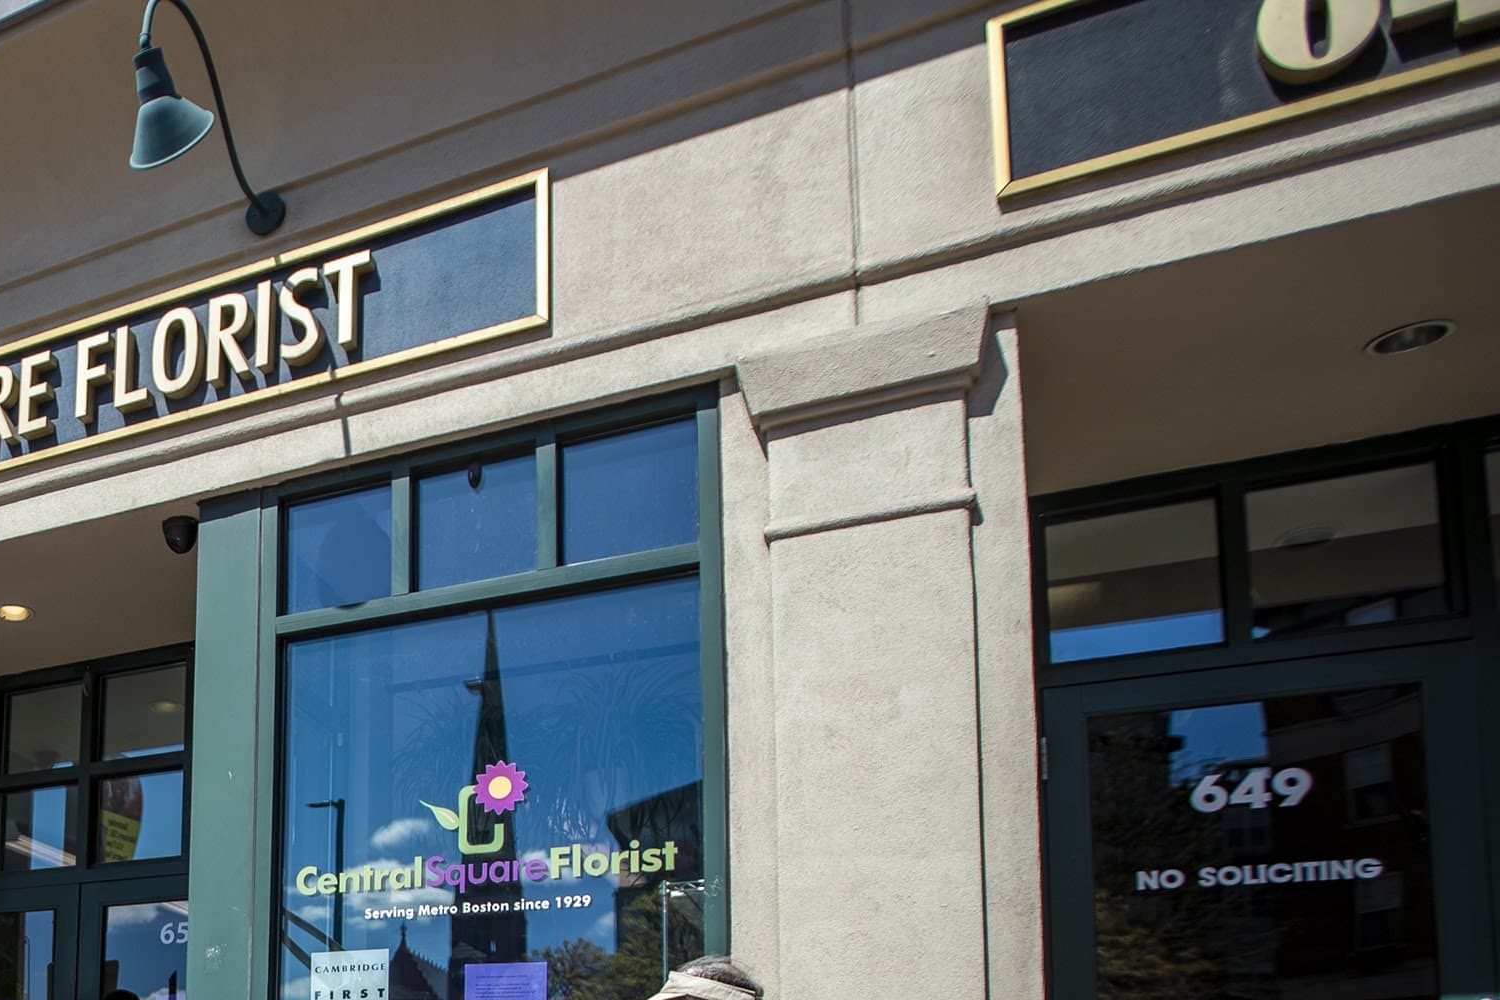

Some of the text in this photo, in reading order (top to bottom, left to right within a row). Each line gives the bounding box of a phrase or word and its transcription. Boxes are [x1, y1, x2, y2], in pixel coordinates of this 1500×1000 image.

[75, 249, 373, 420] FLORIST
[1190, 767, 1313, 813] 649
[295, 839, 678, 896] CentralSquareFlorist
[1135, 858, 1384, 891] NO SOLICITING
[364, 895, 592, 920] Serving Metro Boston since 1929
[314, 963, 387, 975] CAMBRIDGE
[314, 988, 386, 1000] FIRST
